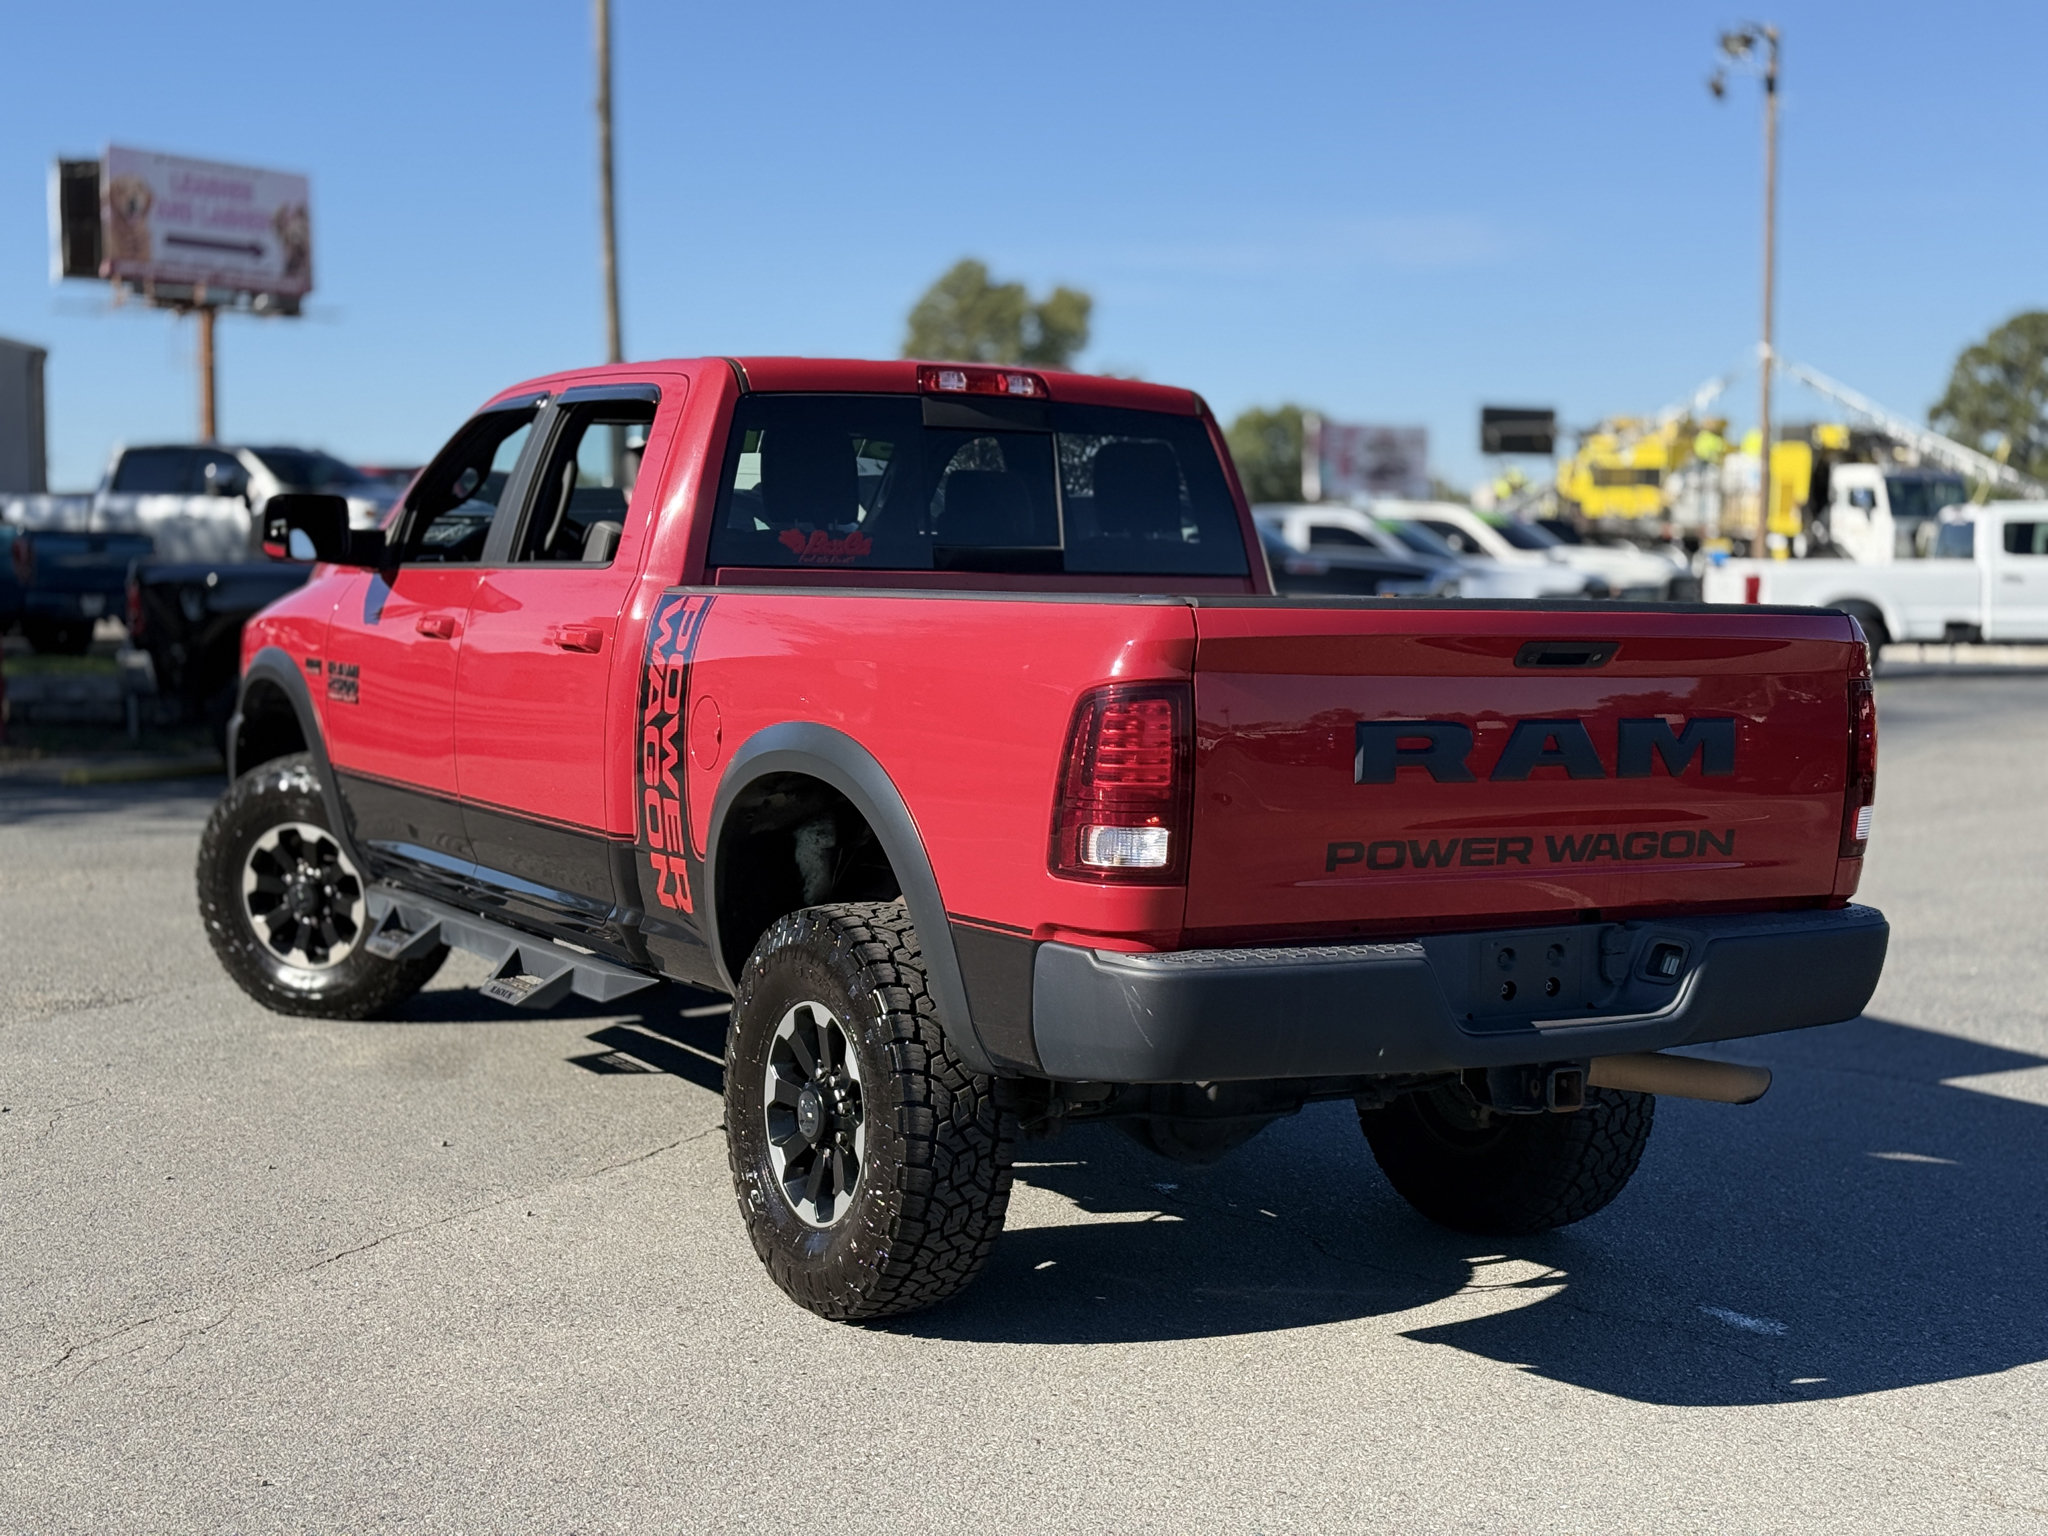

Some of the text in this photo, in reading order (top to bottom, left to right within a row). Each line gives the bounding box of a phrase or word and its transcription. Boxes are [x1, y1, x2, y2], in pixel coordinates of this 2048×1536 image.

[327, 661, 360, 678] RAM
[643, 596, 685, 910] WAGON
[662, 596, 706, 914] POWER
[1354, 716, 1736, 785] RAM
[1324, 828, 1736, 873] POWER WAGON
